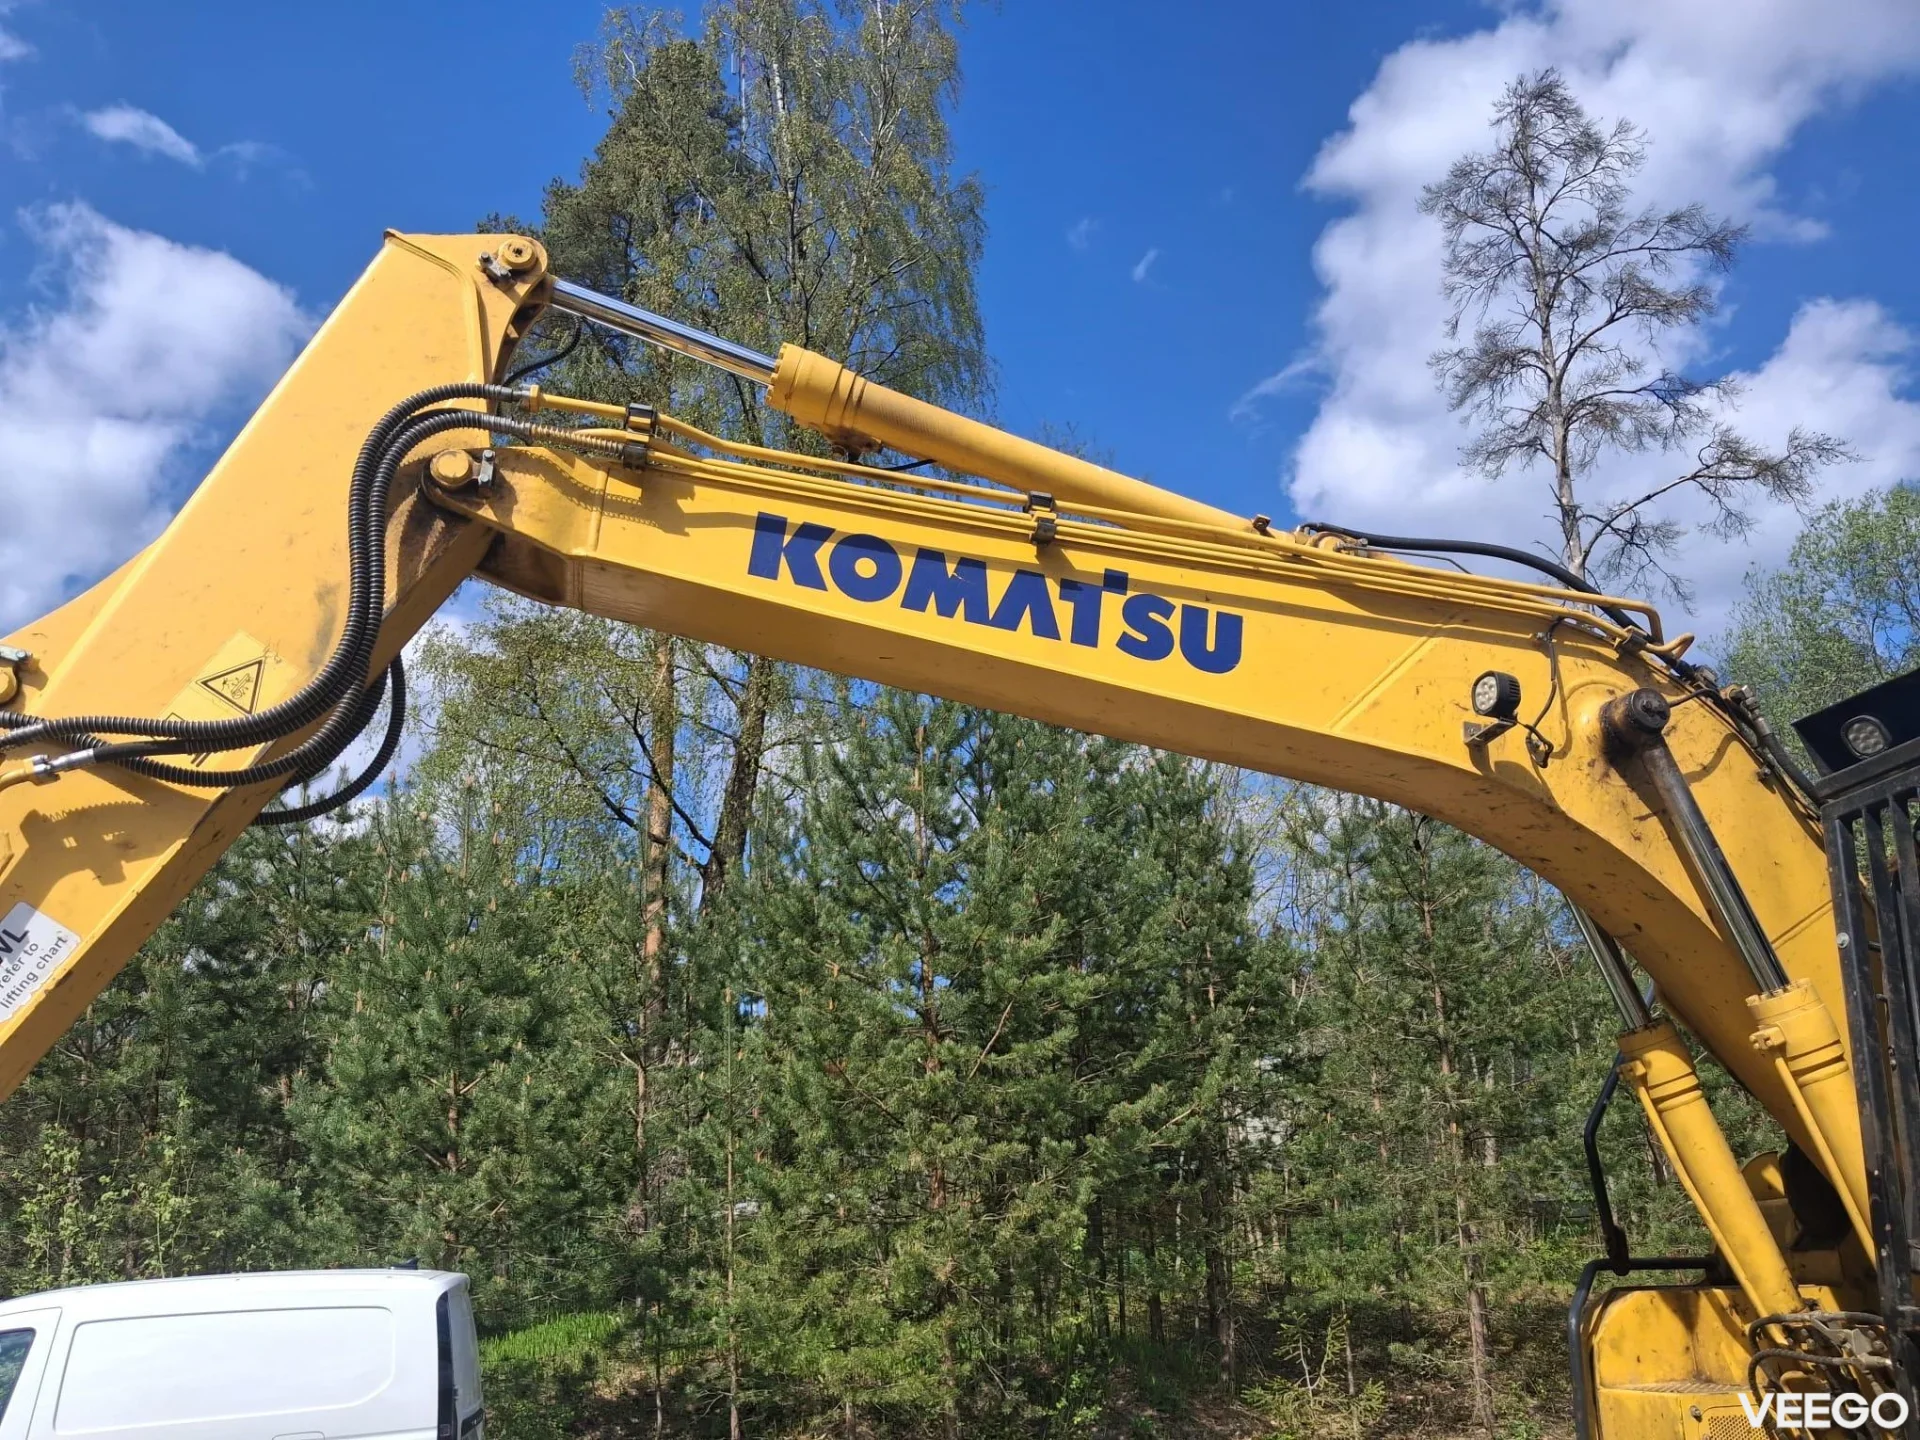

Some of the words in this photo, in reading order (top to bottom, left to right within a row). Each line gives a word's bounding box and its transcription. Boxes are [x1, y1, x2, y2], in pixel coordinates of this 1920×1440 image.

[748, 512, 1243, 674] KOMATSU
[0, 972, 39, 1008] lifting
[36, 936, 68, 970] chart
[23, 943, 39, 956] to
